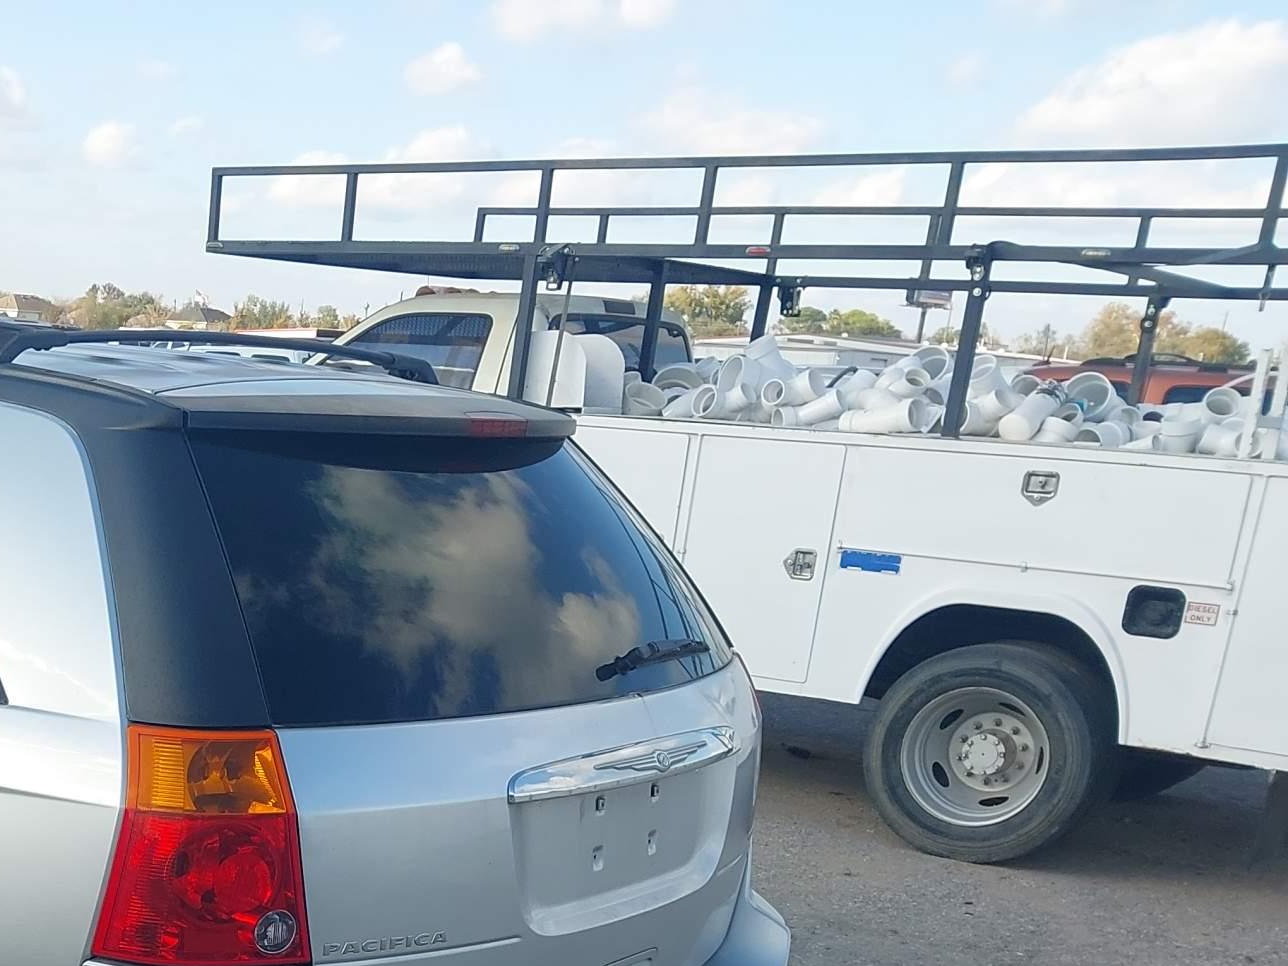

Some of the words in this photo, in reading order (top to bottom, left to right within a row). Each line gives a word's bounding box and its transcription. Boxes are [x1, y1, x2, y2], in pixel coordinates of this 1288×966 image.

[1188, 604, 1217, 614] DIESEL
[1190, 614, 1212, 622] ONLY
[322, 930, 448, 957] PACIFICA
